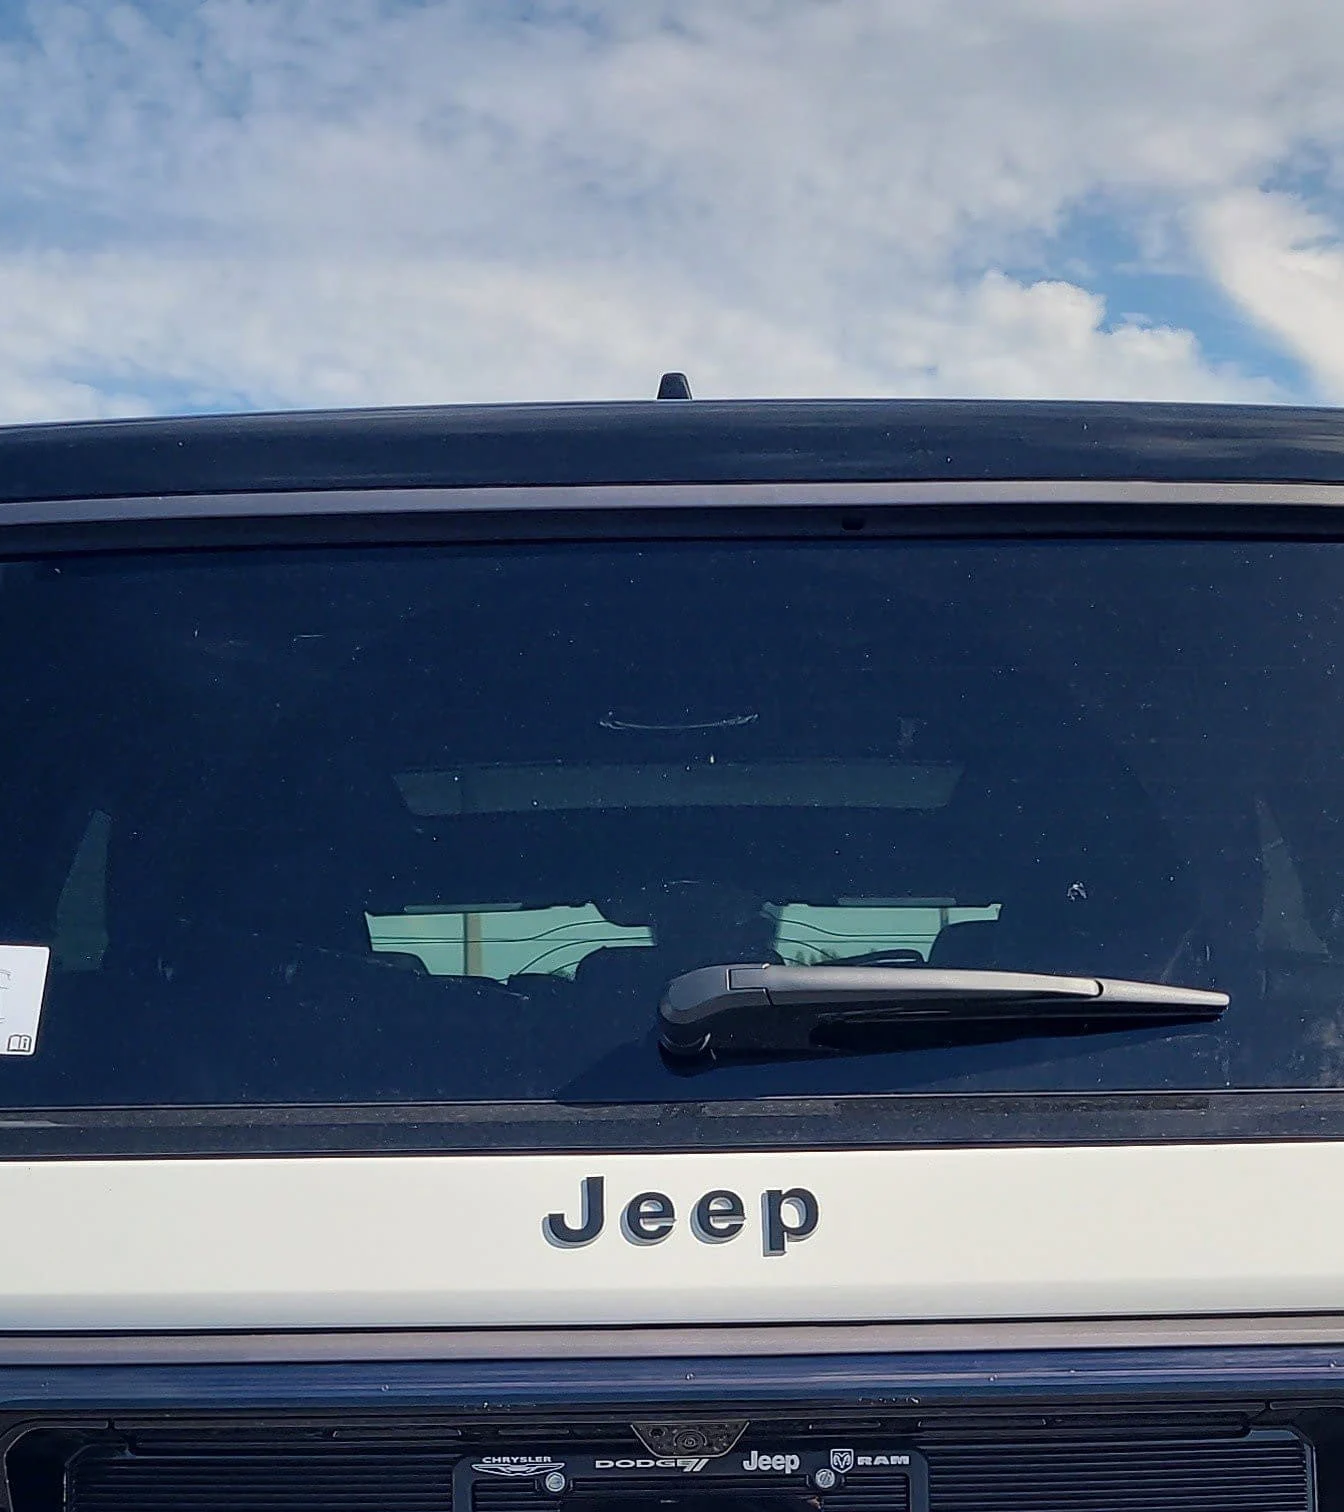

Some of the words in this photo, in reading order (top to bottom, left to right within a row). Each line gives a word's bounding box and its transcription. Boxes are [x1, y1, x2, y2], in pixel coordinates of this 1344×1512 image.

[542, 1175, 819, 1257] Jeep
[482, 1456, 552, 1464] CHRYSLER
[595, 1458, 699, 1469] DODGE
[742, 1450, 800, 1474] Jeep
[857, 1455, 911, 1466] RAM
